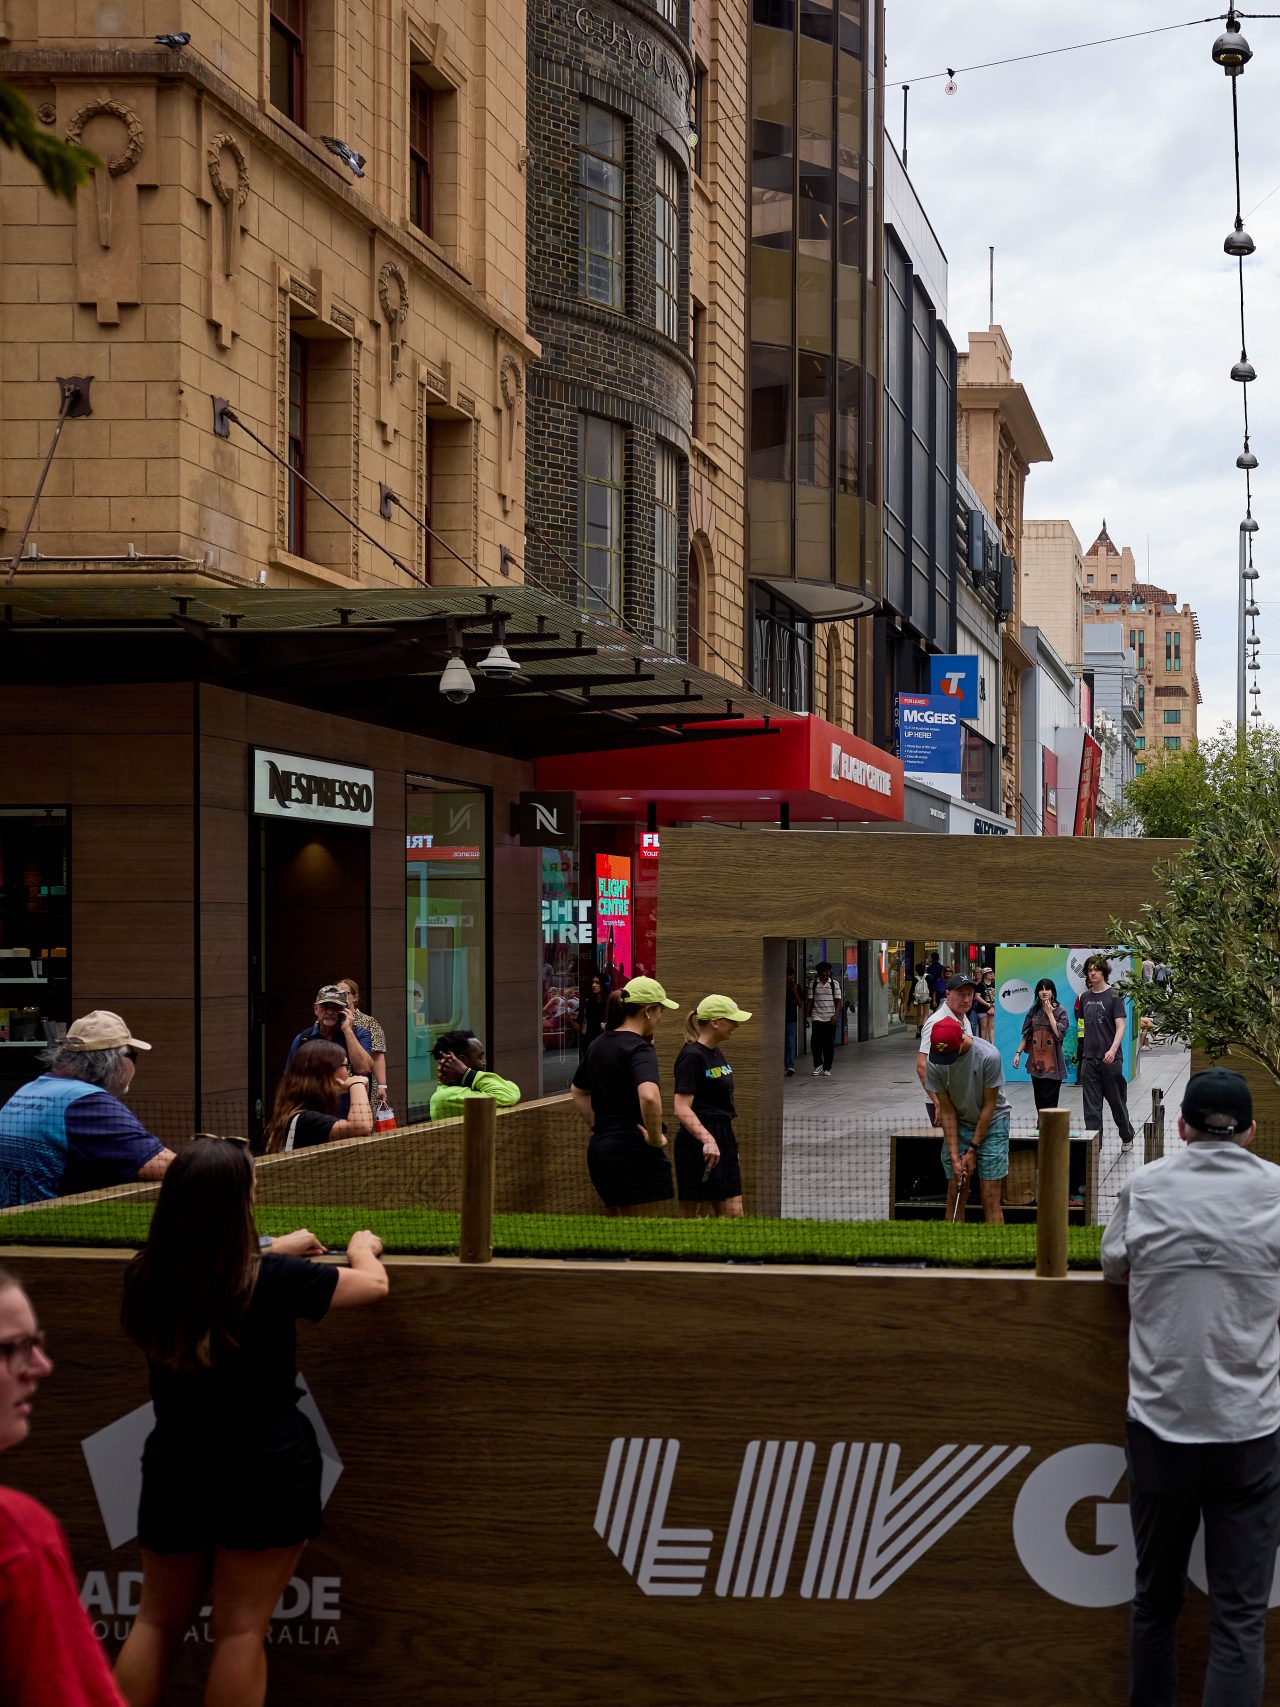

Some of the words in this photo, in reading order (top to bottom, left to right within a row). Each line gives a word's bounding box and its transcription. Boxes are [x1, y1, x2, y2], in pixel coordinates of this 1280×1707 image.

[903, 709, 957, 725] McGEES
[841, 751, 868, 787] FLIGHT
[866, 764, 892, 797] CENTRE
[263, 760, 372, 813] NESPRESSO
[598, 877, 629, 898] FLIGHT
[597, 897, 630, 916] CENTRE
[542, 923, 593, 943] TRE
[593, 1437, 1032, 1600] LIV
[79, 1570, 342, 1621] ADDE
[184, 1625, 340, 1646] AURALIA
